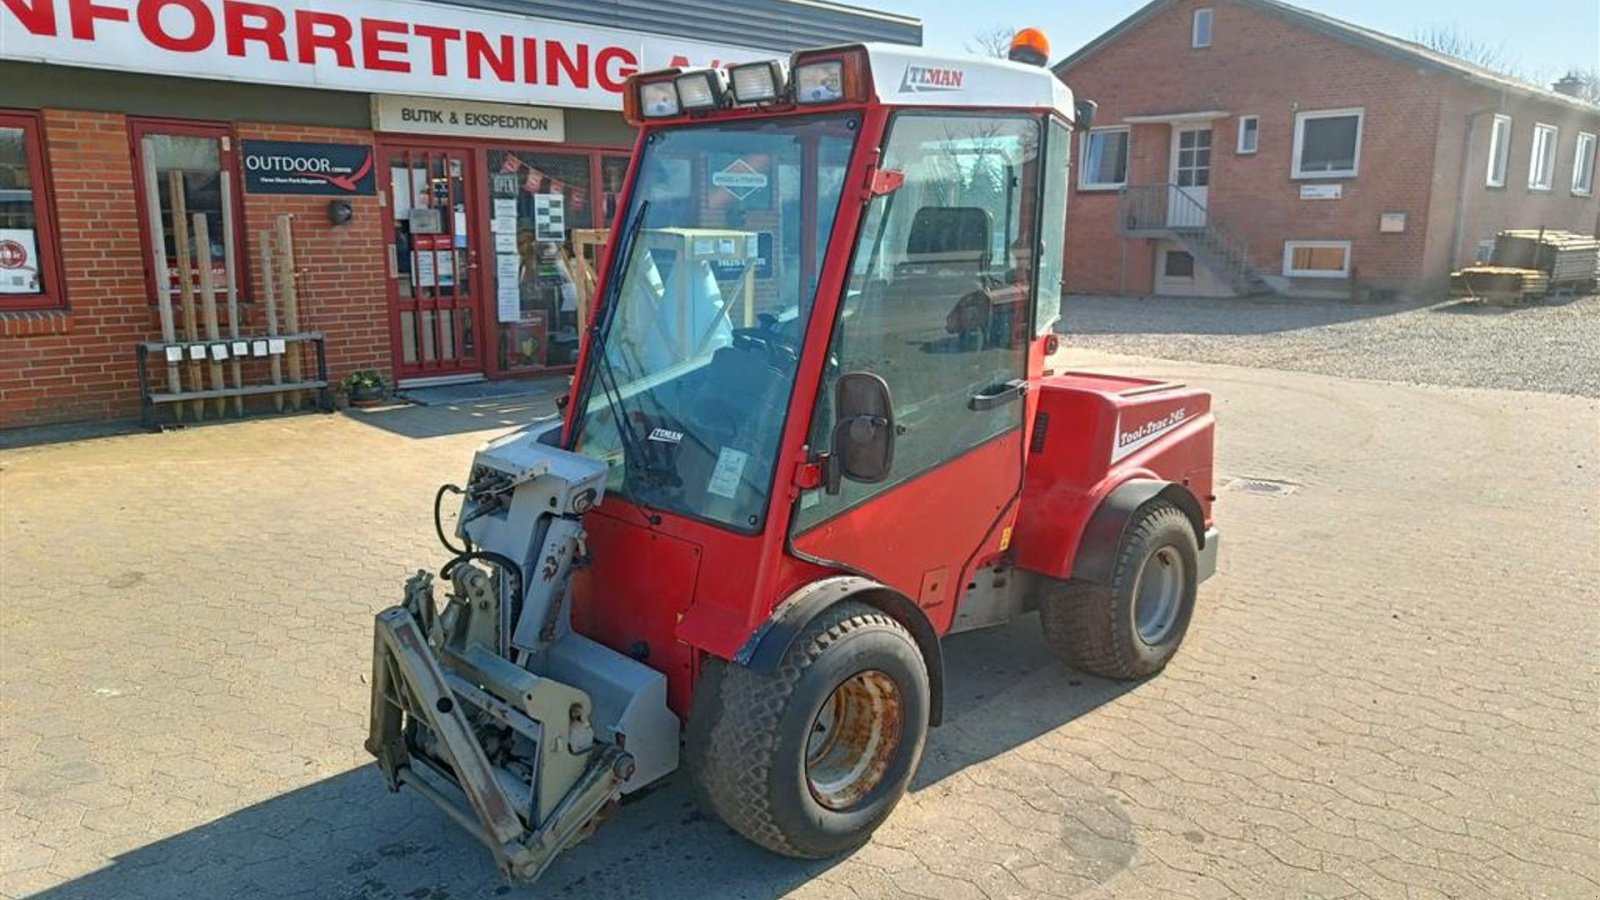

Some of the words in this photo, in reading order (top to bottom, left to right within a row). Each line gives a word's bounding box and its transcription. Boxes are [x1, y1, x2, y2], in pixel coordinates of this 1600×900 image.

[906, 66, 964, 88] TIMAN
[401, 107, 443, 124] BUTIK
[449, 112, 459, 124] &
[465, 113, 548, 131] EKSPEDITION
[246, 155, 331, 172] OUTDOOR
[653, 427, 684, 441] TIMAN
[1120, 418, 1168, 446] Tool-Trac
